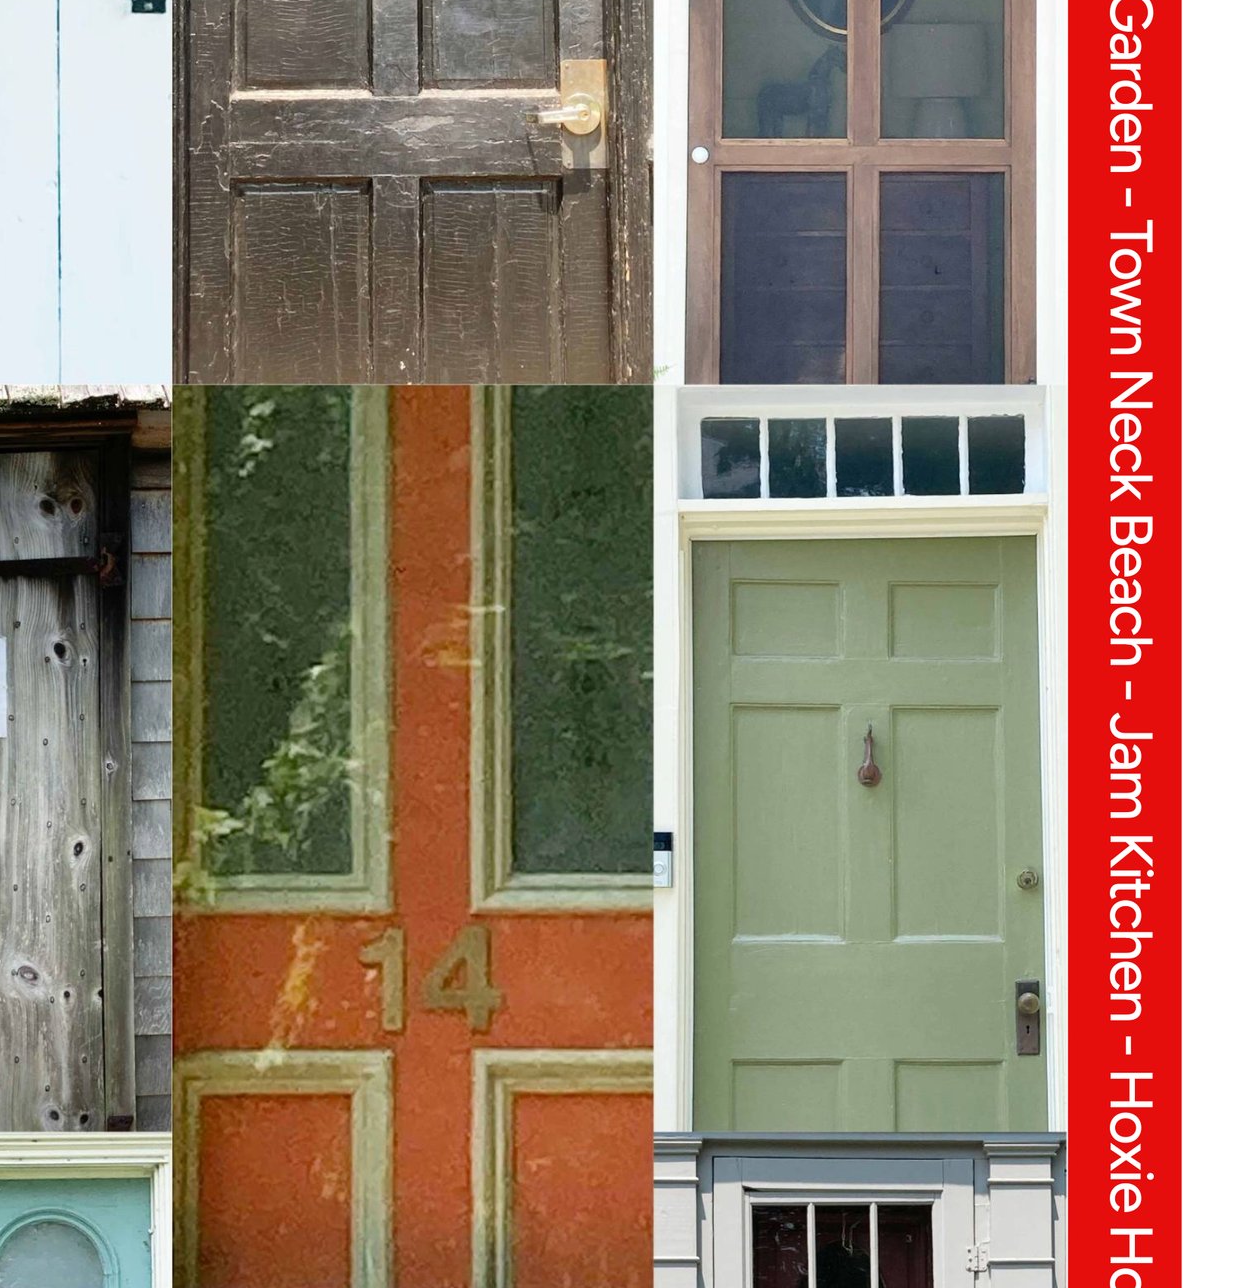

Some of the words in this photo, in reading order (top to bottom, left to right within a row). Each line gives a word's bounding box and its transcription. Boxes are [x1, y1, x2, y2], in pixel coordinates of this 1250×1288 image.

[1109, 219, 1154, 355] Town
[1109, 371, 1154, 502] Neck
[1109, 516, 1154, 666] Beach
[1109, 712, 1154, 819] Jam
[358, 925, 507, 1033] 14
[1109, 835, 1155, 1021] Kitchen
[1109, 1072, 1155, 1213] Hoxie
